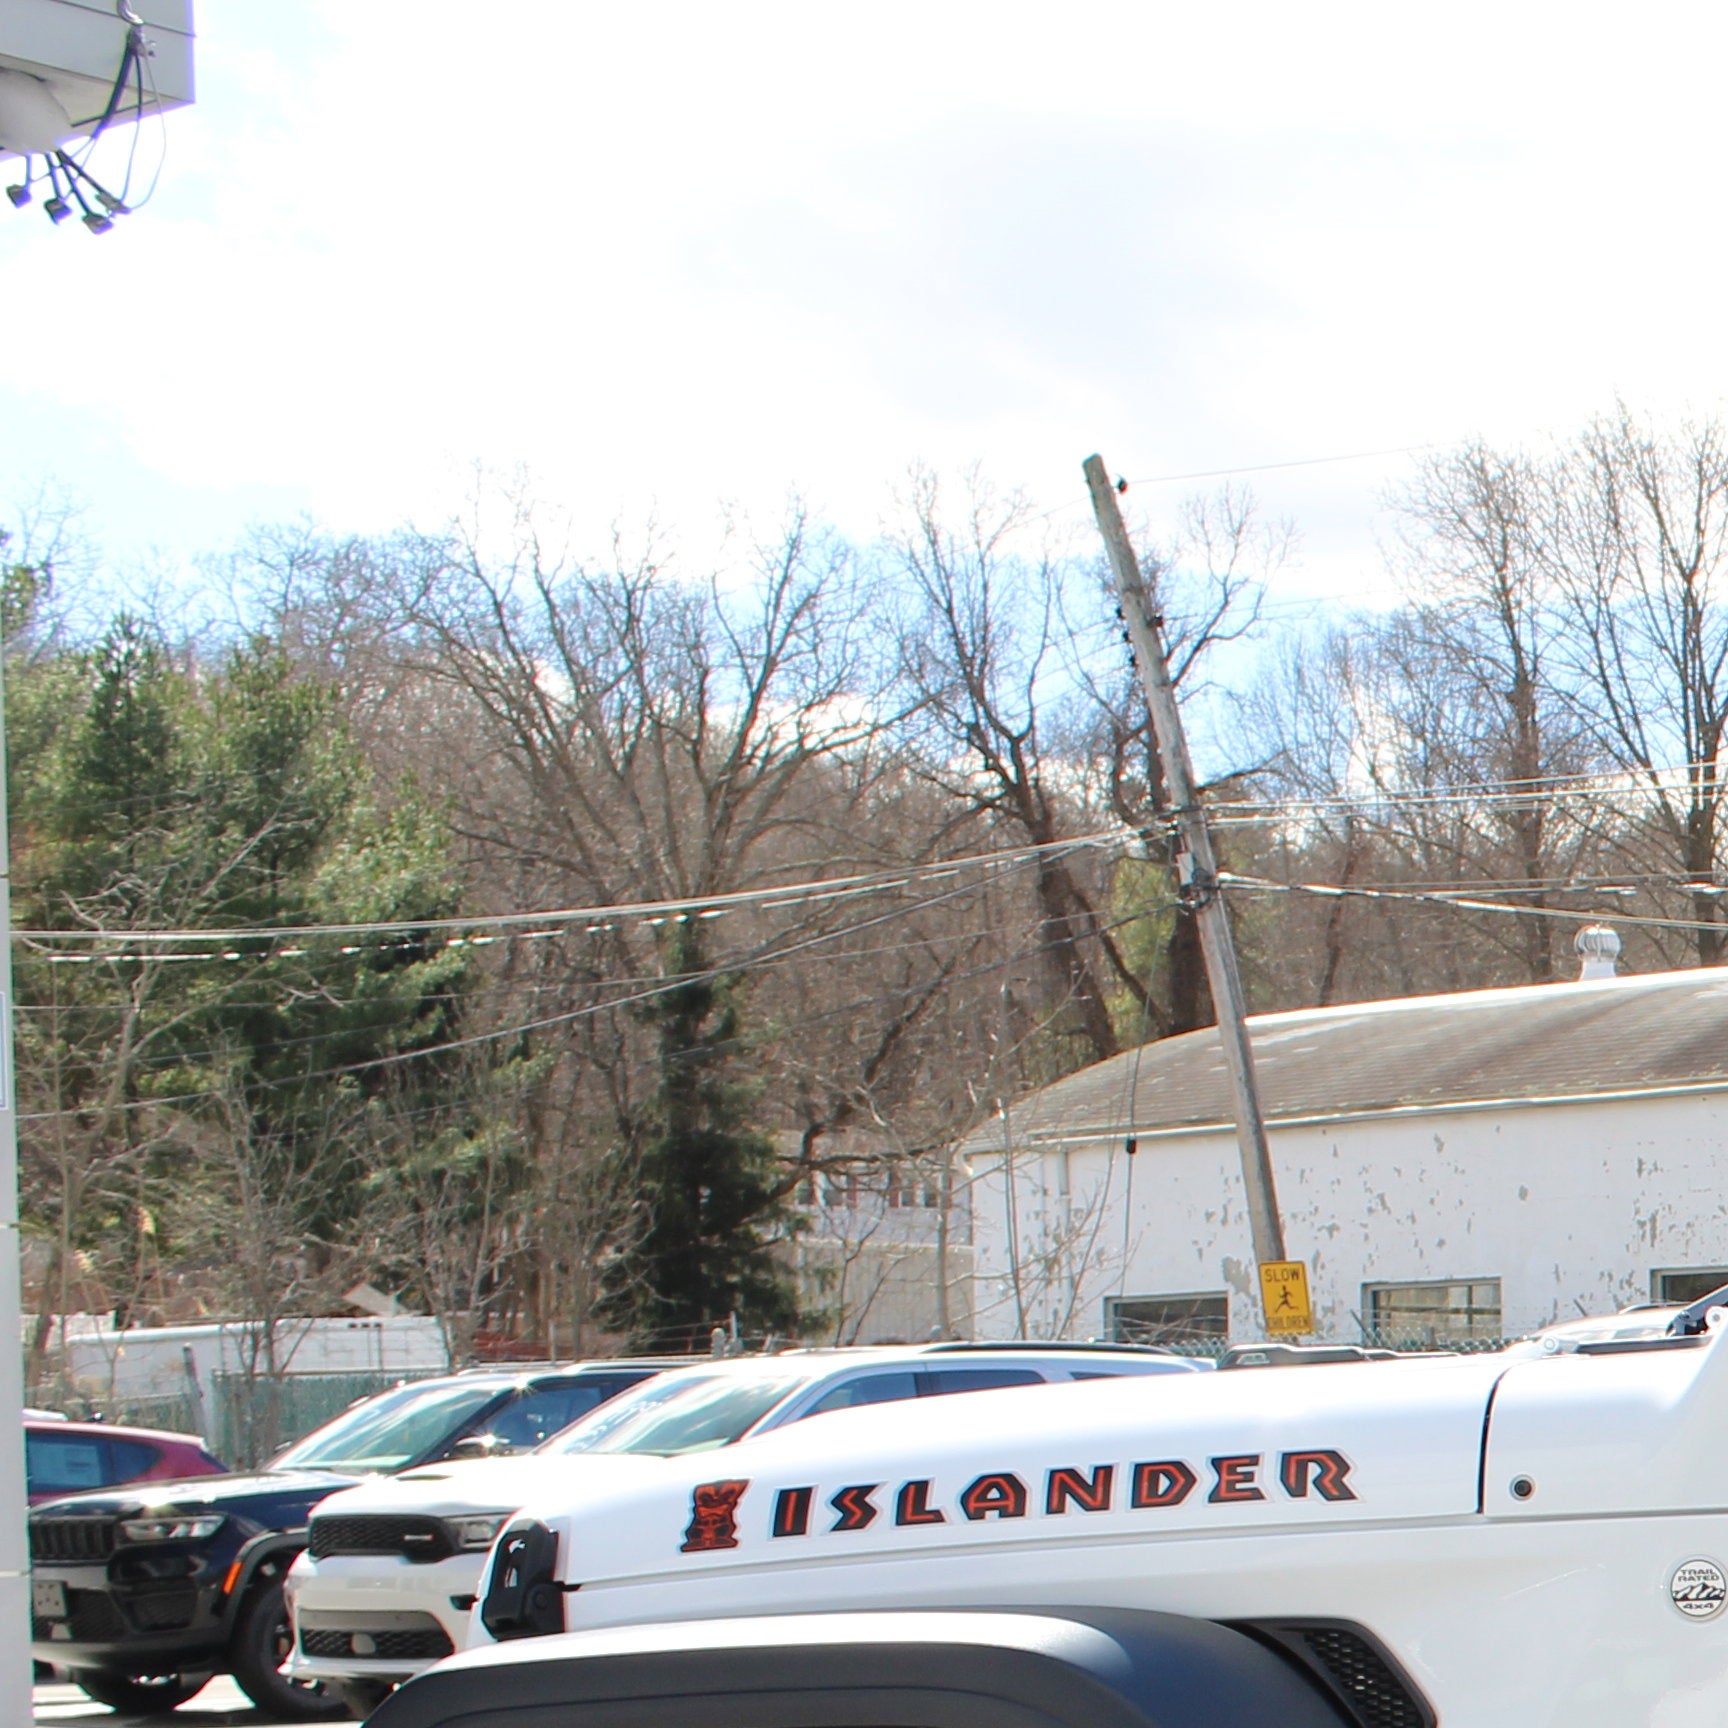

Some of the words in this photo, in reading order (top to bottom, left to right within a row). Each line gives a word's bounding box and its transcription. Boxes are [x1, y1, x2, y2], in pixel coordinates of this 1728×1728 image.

[1264, 1268, 1300, 1282] SLOW
[772, 1449, 1358, 1538] ISLANDER
[1678, 1574, 1720, 1582] RATED
